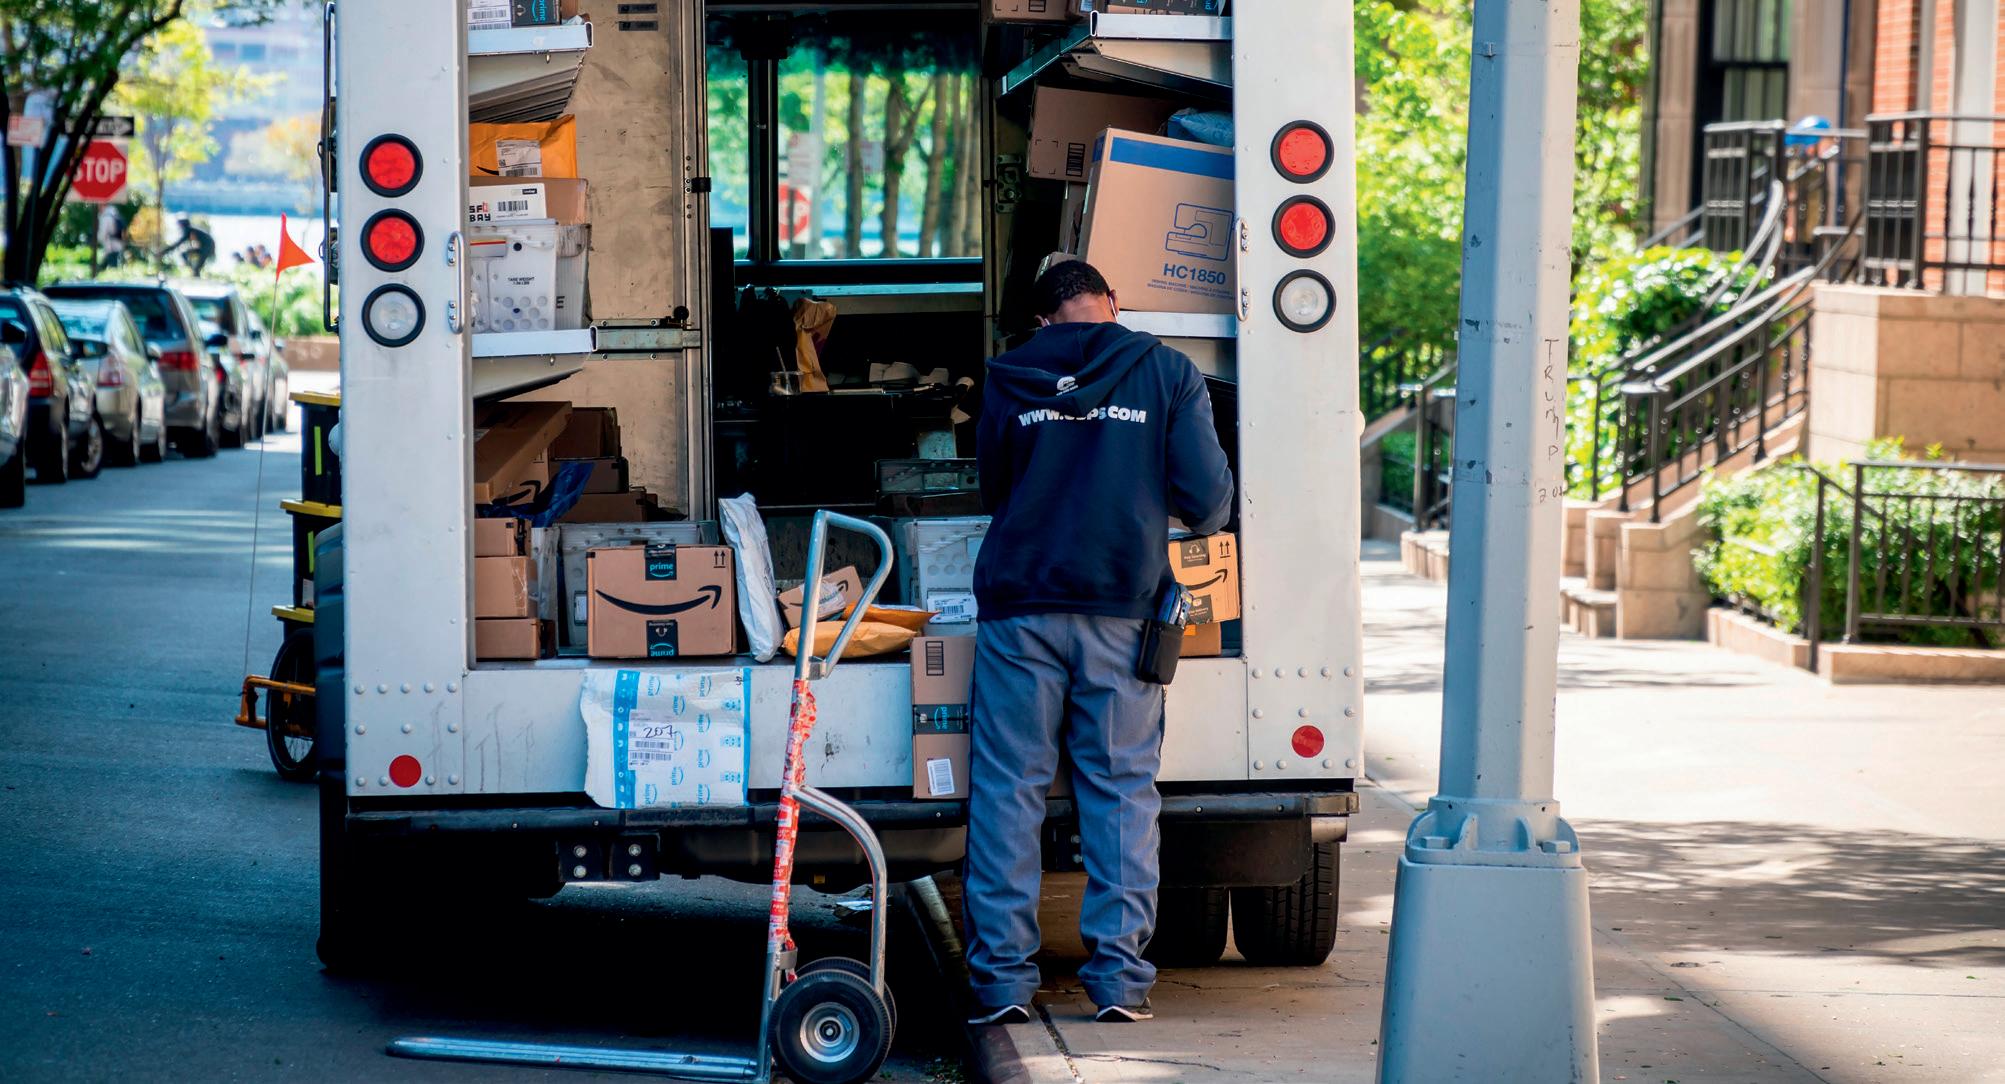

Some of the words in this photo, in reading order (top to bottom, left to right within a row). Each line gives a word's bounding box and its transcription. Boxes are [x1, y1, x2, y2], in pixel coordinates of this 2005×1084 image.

[469, 213, 491, 222] BAY
[1163, 263, 1226, 285] HC1850
[649, 561, 674, 571] prime
[650, 648, 675, 657] prime
[643, 725, 677, 739] 207
